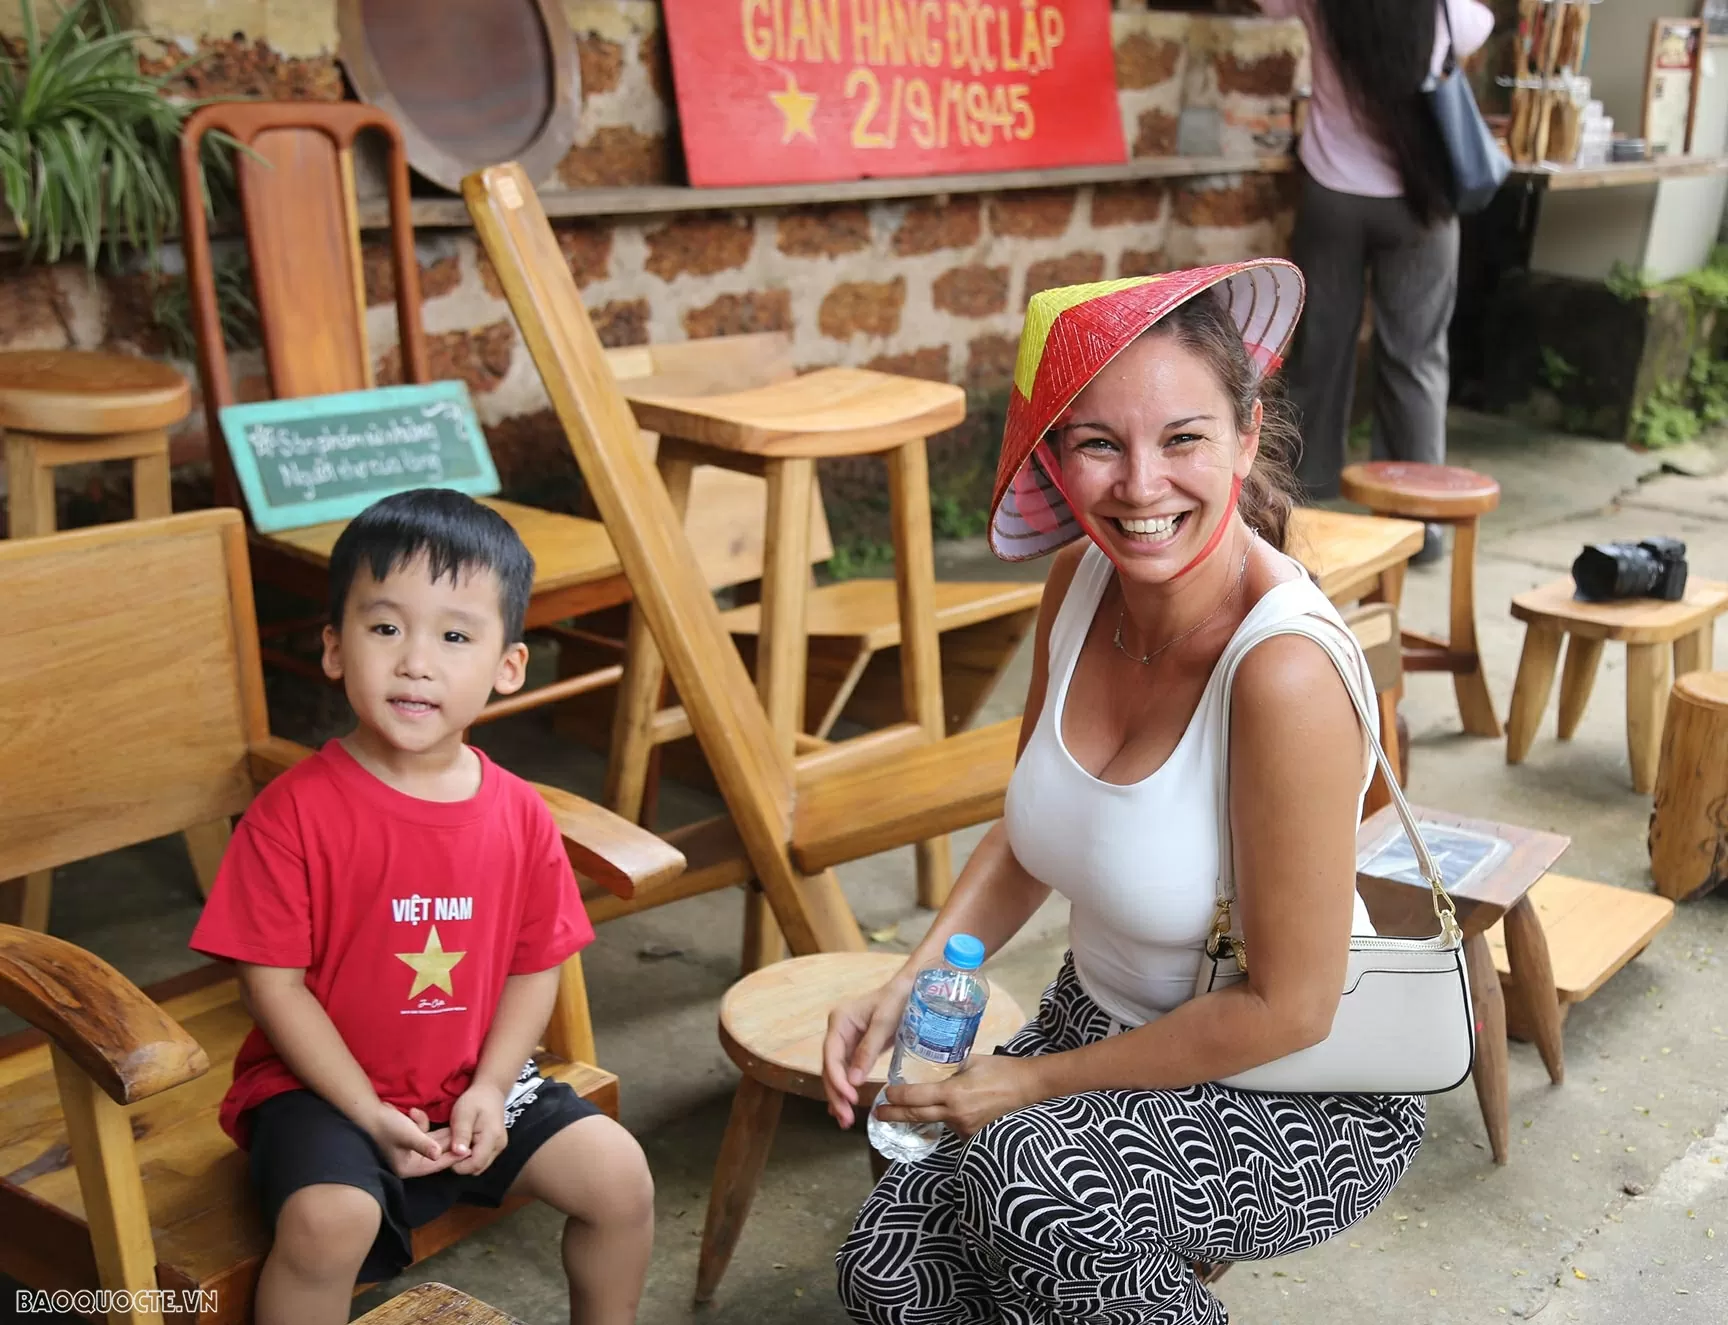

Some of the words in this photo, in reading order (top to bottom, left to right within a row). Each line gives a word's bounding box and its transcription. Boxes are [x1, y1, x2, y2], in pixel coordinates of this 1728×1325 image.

[741, 0, 842, 63] GIAN
[843, 67, 1036, 149] 2/9/1945
[392, 893, 432, 926] VIỆT
[434, 896, 473, 921] NAM
